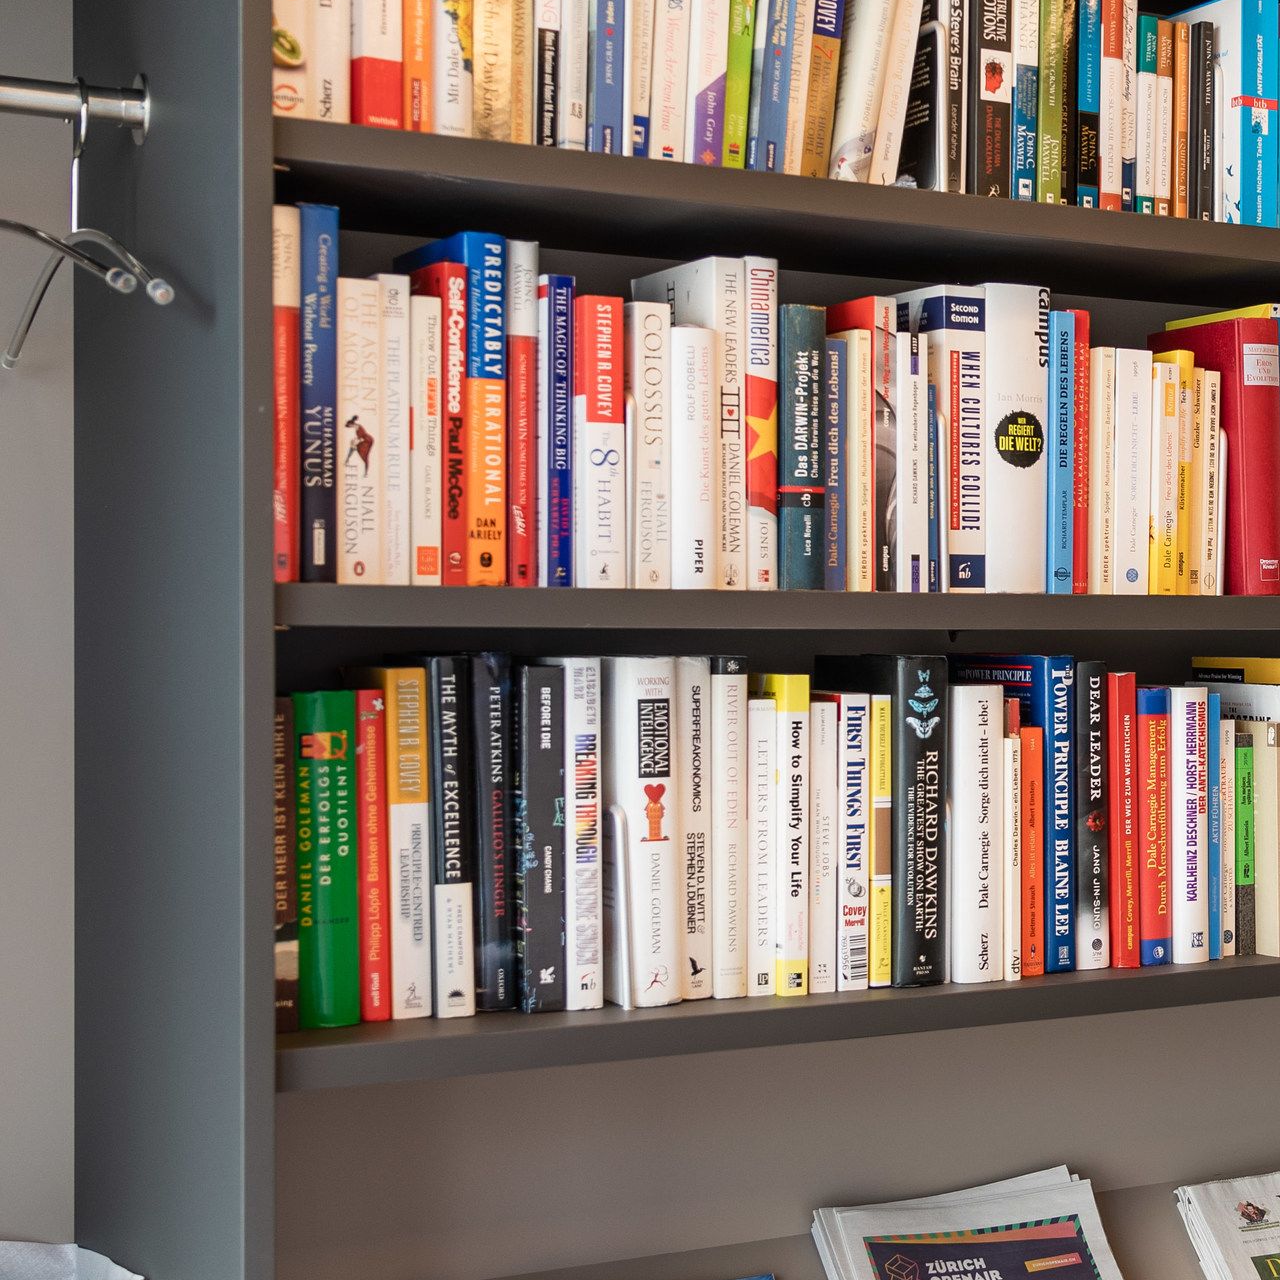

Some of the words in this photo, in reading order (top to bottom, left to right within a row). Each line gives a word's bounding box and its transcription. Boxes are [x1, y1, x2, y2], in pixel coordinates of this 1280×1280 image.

[950, 55, 962, 91] Brain
[1253, 98, 1267, 109] btb
[484, 242, 501, 377] PREDICTABLY
[556, 287, 567, 313] THE
[750, 268, 775, 366] Chinamerica
[448, 276, 465, 414] Self-Confidence
[556, 316, 567, 357] MAGIC
[597, 304, 612, 359] STEPHEN
[556, 358, 567, 376] OF
[643, 313, 663, 447] COLOSSUS
[962, 351, 980, 389] WHEN
[555, 380, 567, 445] THINKING
[597, 377, 612, 417] COVEY
[449, 417, 462, 450] Paul
[484, 385, 501, 505] IRRATIONAL
[961, 399, 980, 467] CULTURES
[999, 437, 1013, 451] DIE
[1015, 436, 1041, 451] WELT?
[1008, 425, 1034, 436] REGIERT
[556, 446, 567, 470] BIG
[448, 452, 460, 520] McGee
[961, 475, 980, 531] COLLIDE
[477, 518, 496, 529] DAN
[441, 674, 456, 705] THE
[1089, 676, 1101, 724] DEAR
[442, 712, 458, 759] MYTH
[640, 701, 654, 775] INTELLIGENCE
[654, 701, 669, 774] EMOTIONAL
[692, 685, 701, 813] SUPERFREAKONOMICS
[792, 720, 803, 748] How
[846, 705, 866, 752] FIRST
[1186, 701, 1197, 759] HERRMANN
[792, 754, 803, 769] to
[1054, 740, 1069, 831] PRINCIPLE
[1089, 730, 1102, 801] LEADER
[1187, 762, 1197, 789] HORST
[790, 774, 803, 832] Simplify
[846, 757, 866, 817] THINGS
[926, 750, 938, 840] RICHARD
[443, 781, 461, 880] EXCELLENCE
[1187, 797, 1197, 847] DESCHNER
[792, 835, 803, 867] Your
[845, 823, 865, 871] FIRST
[1055, 839, 1069, 900] BLAINE
[791, 871, 800, 898] Life
[925, 844, 937, 939] DAWKINS
[1187, 850, 1197, 902] KARLHEINZ
[842, 904, 866, 917] Covey
[1056, 903, 1069, 937] LEE
[926, 1257, 987, 1274] ZÜRICH
